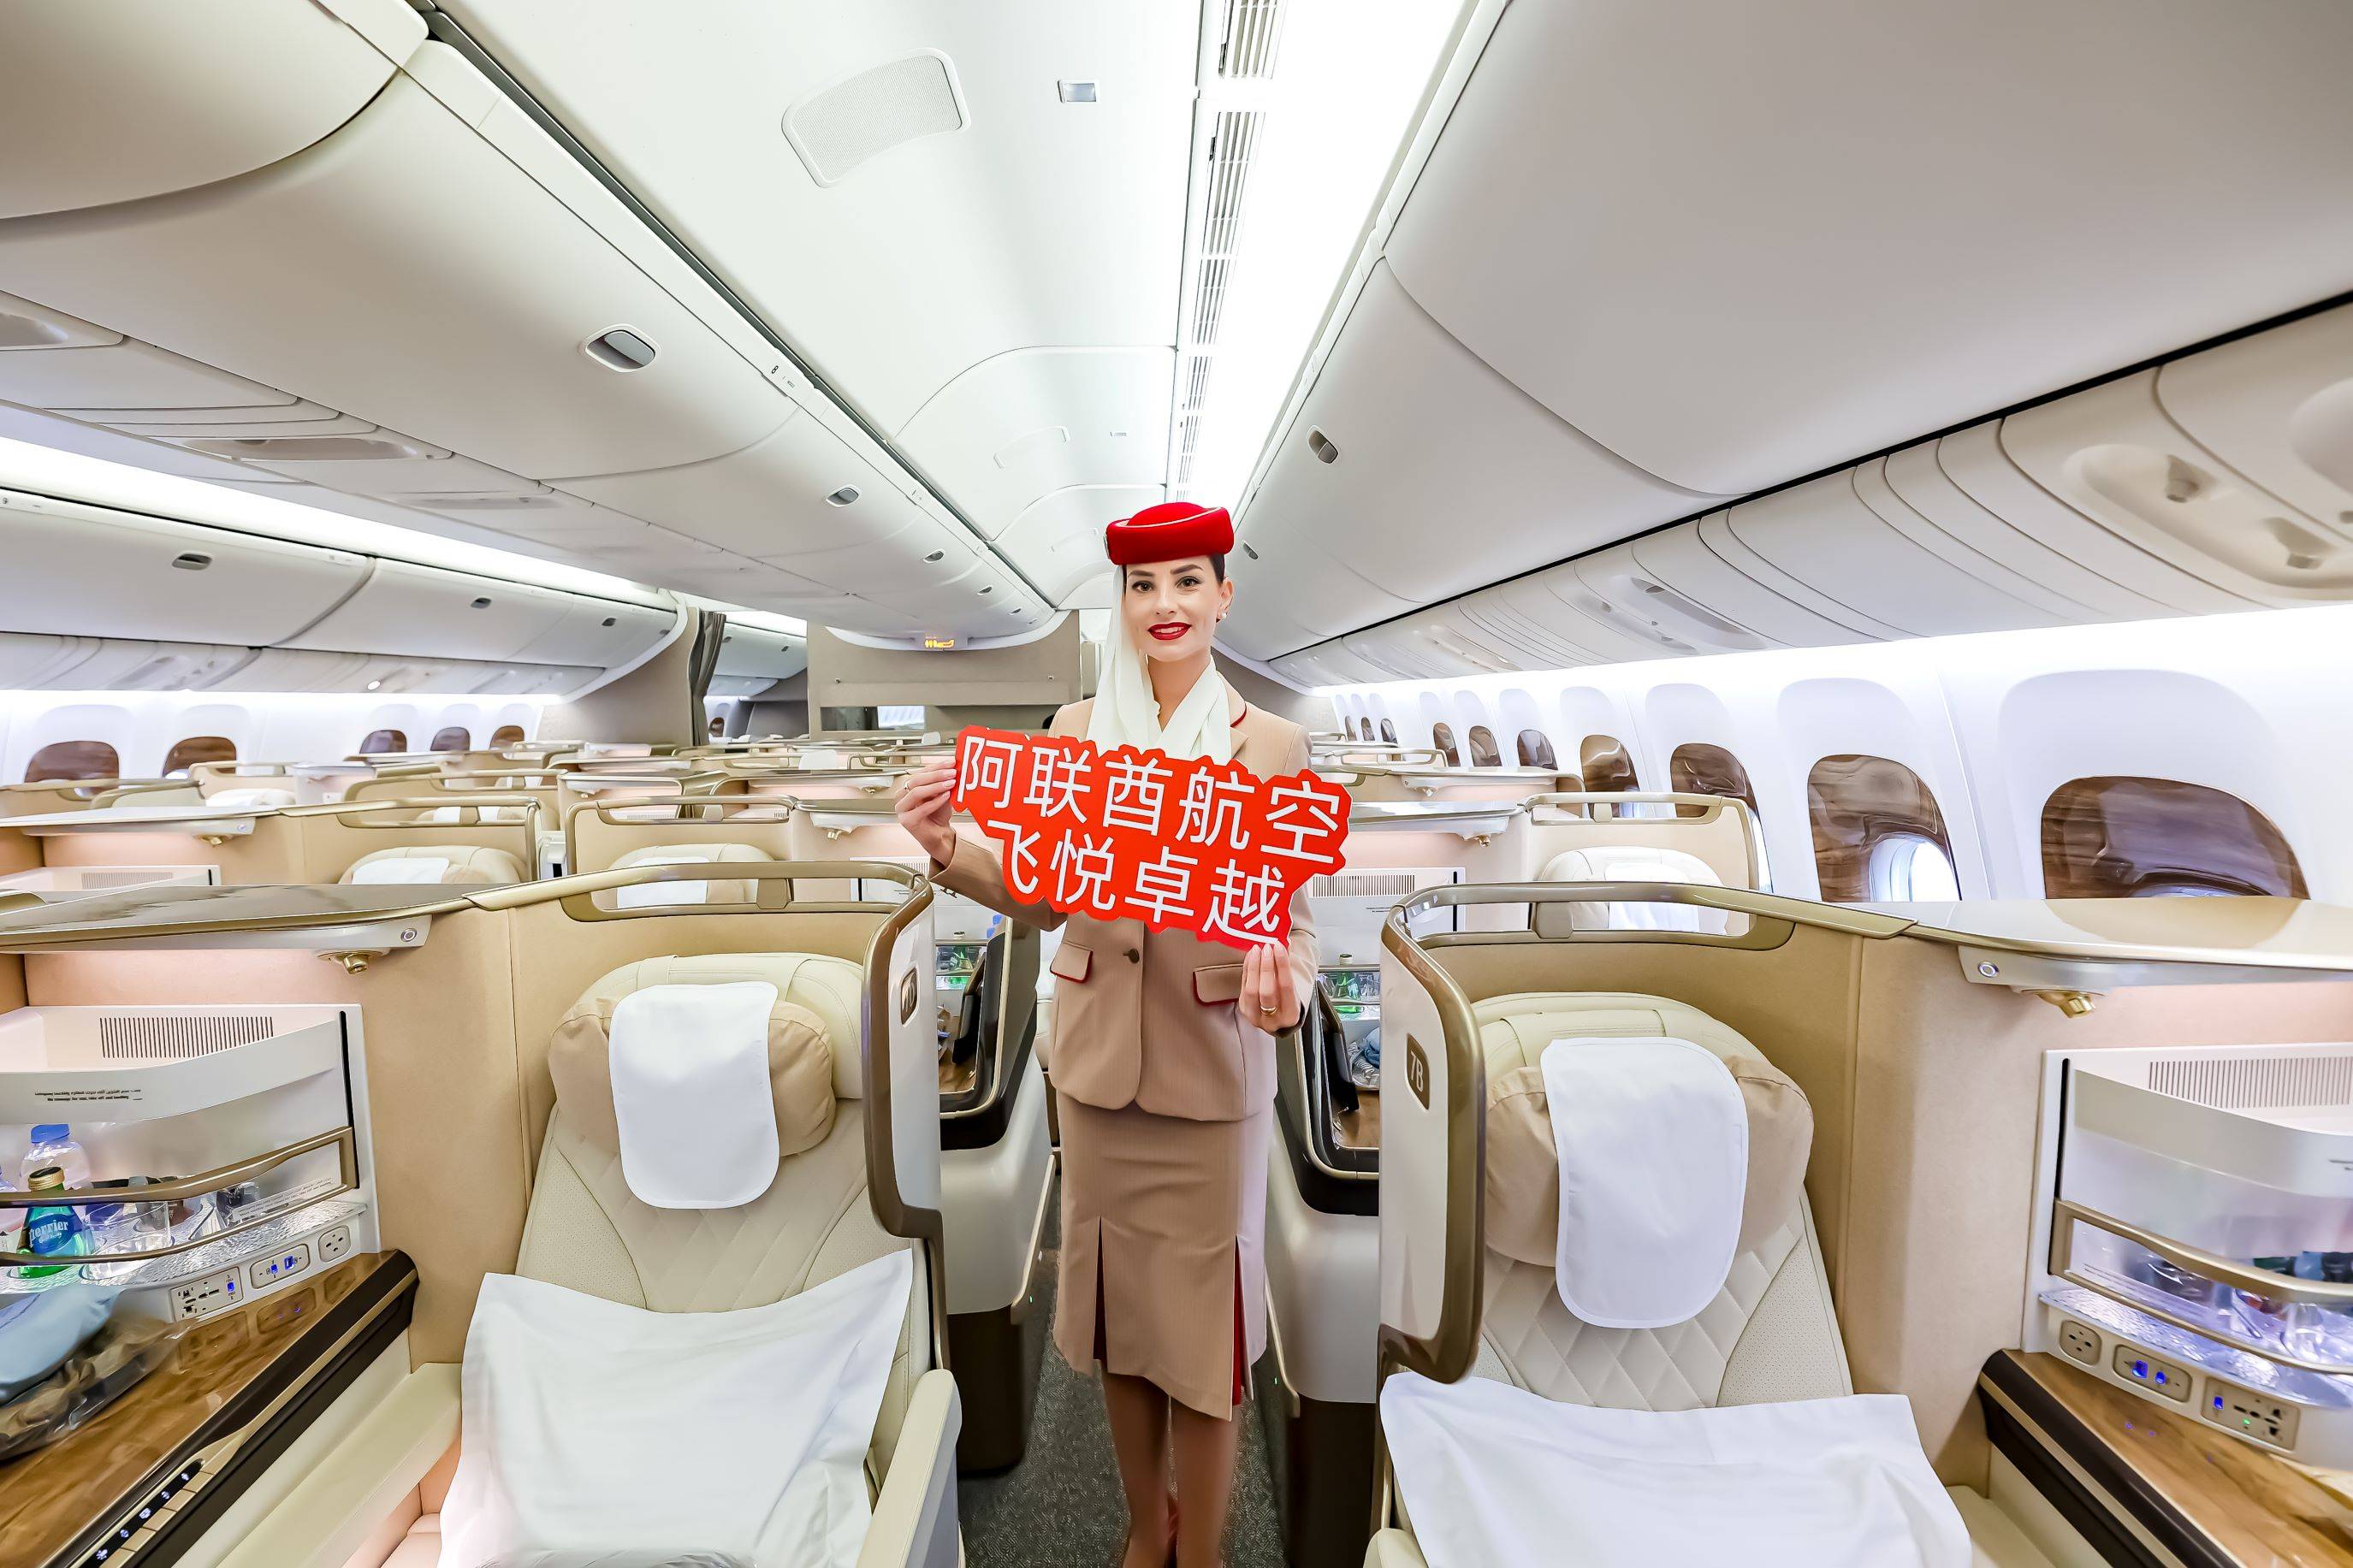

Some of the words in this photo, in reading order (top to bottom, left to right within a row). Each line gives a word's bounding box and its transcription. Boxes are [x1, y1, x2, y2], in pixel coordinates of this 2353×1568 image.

[957, 736, 1341, 865] 阿联酋航空
[986, 819, 1285, 945] 飞悦卓越
[1410, 1050, 1424, 1093] 7B
